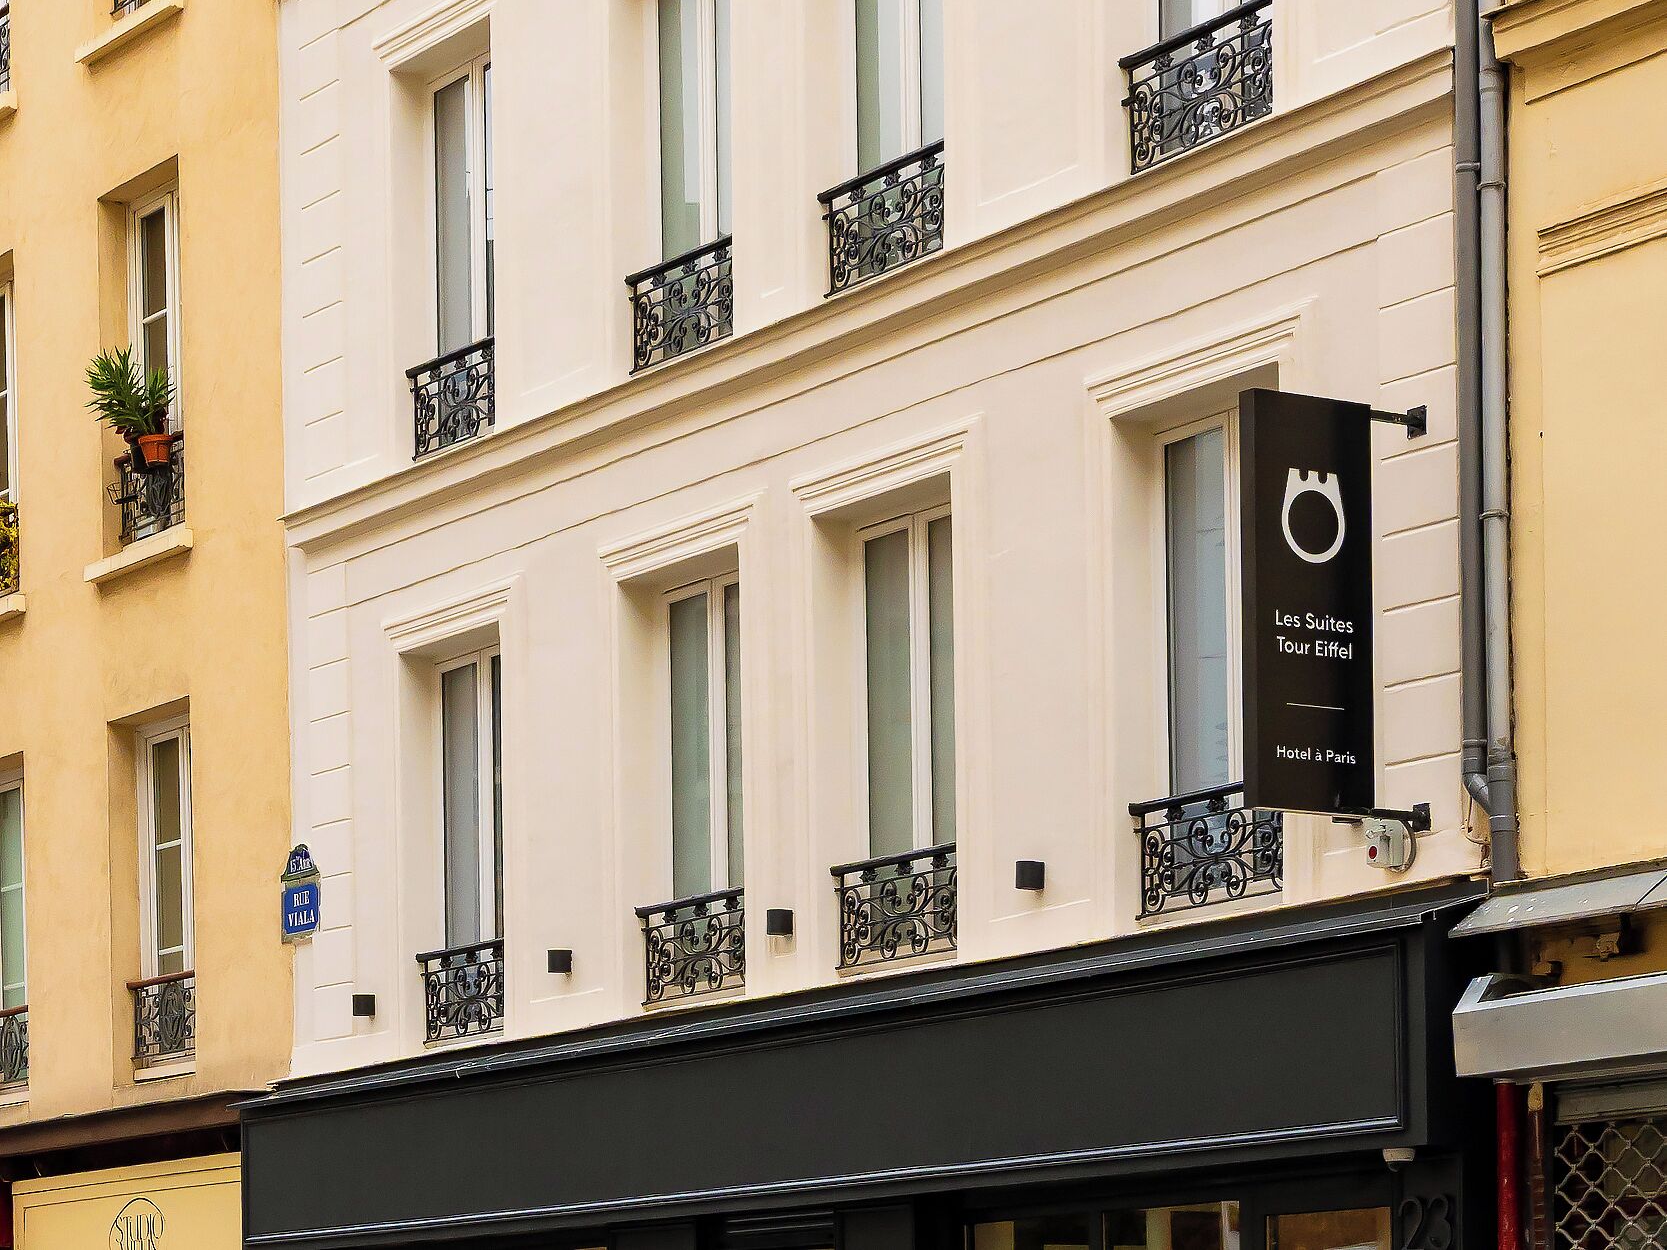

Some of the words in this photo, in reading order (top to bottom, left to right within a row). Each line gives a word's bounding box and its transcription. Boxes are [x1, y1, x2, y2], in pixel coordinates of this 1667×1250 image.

[1275, 609, 1301, 628] Les
[1305, 612, 1354, 634] Suites
[1276, 635, 1311, 655] Tour
[1315, 639, 1353, 660] Eiffel
[1276, 744, 1311, 761] Hotel
[1314, 748, 1323, 762] à
[1325, 750, 1356, 765] Paris
[294, 890, 310, 907] RUE
[288, 909, 314, 927] VIALA
[115, 1212, 164, 1242] STUDIO
